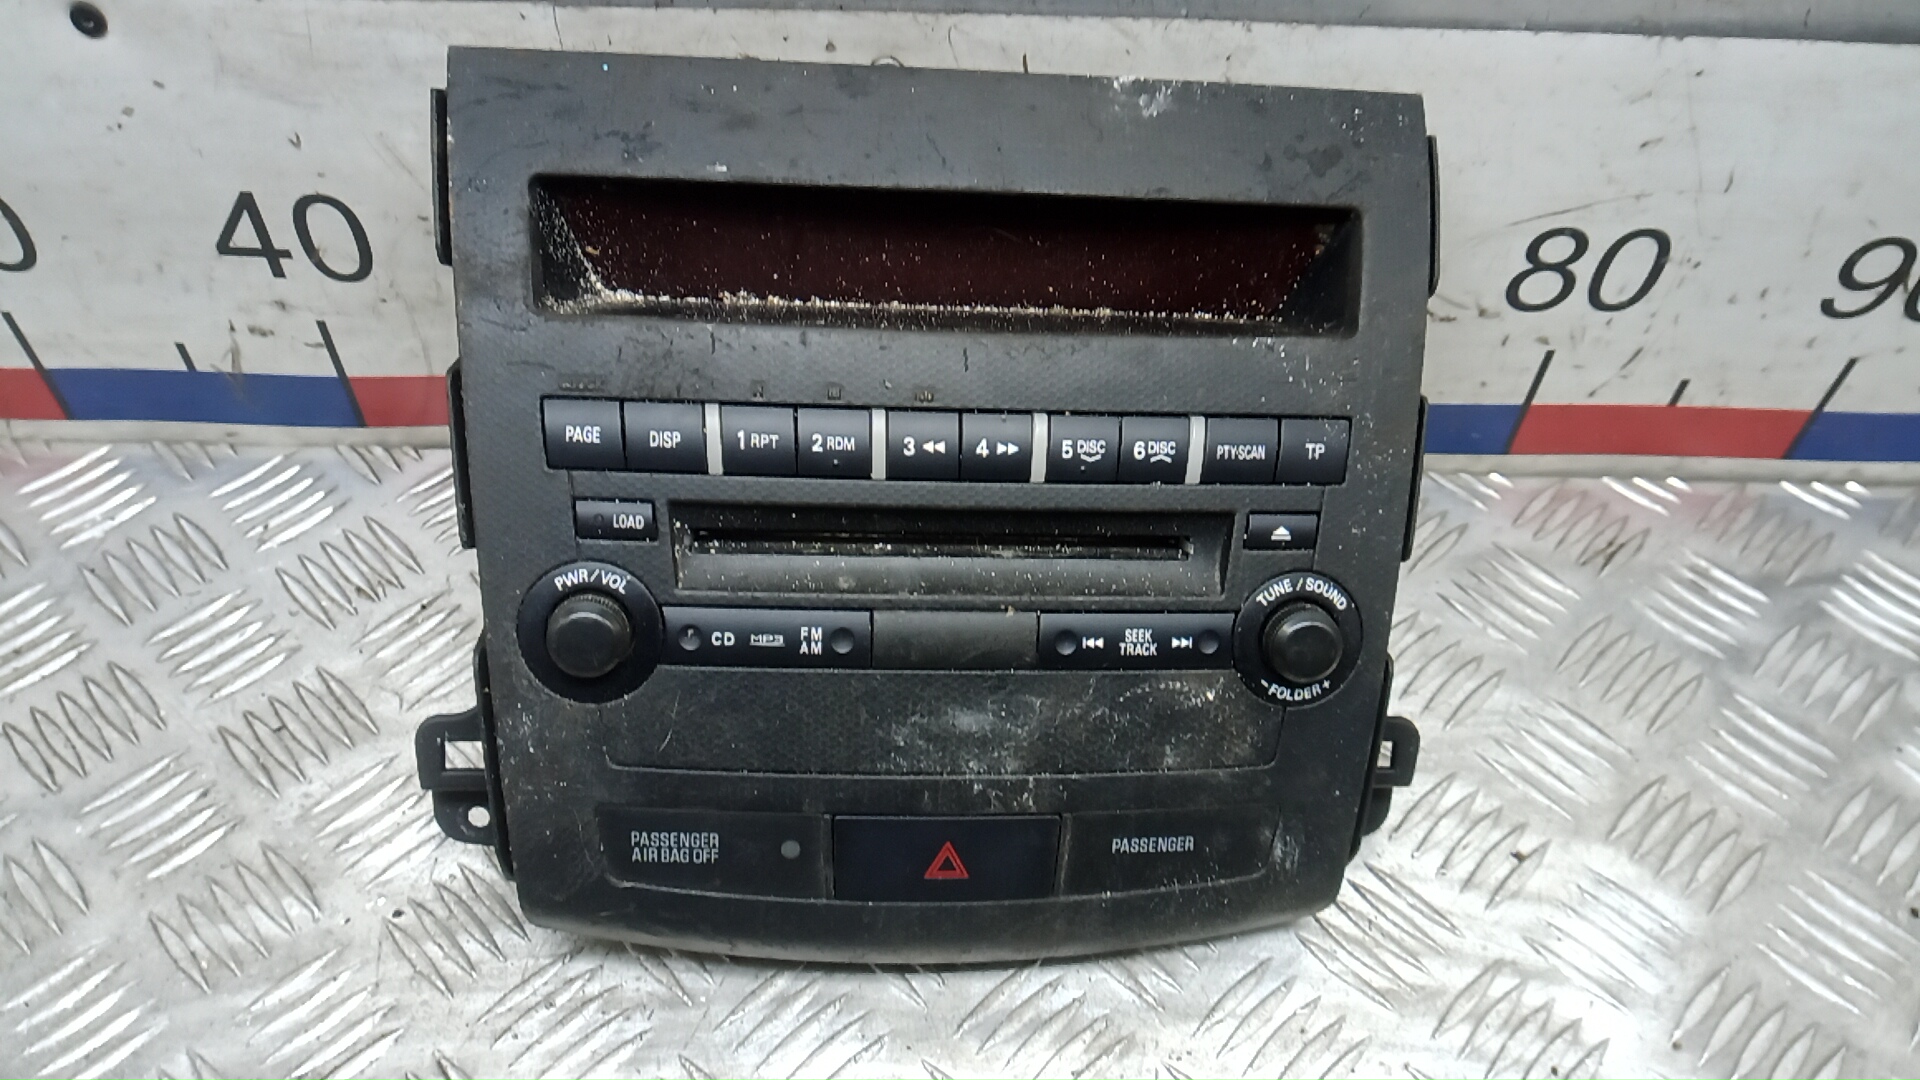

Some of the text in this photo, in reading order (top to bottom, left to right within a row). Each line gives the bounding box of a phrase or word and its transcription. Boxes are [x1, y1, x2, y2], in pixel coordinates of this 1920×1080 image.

[215, 191, 373, 282] 40
[1505, 227, 1671, 312] 80
[1820, 236, 1920, 322] 9
[565, 424, 601, 444] PAGE
[649, 430, 681, 449] DISP
[737, 430, 779, 450] 1 RPT
[811, 434, 855, 453] 2 RDM
[903, 437, 915, 456] 3
[975, 438, 989, 457] 4
[1062, 439, 1106, 459] 5 DISC
[1133, 441, 1176, 460] 6 DISC
[1305, 443, 1325, 460] TP
[613, 514, 645, 530] LOAD
[711, 632, 735, 646] CD
[750, 633, 784, 647] MP3
[800, 626, 822, 641] FM
[1124, 628, 1152, 644] SEEK
[799, 641, 822, 655] AM
[1119, 643, 1158, 657] TRACK
[630, 831, 719, 848] PASSENGER
[1111, 835, 1195, 854] PASSENGER
[631, 847, 719, 864] AIR BAG OFF
